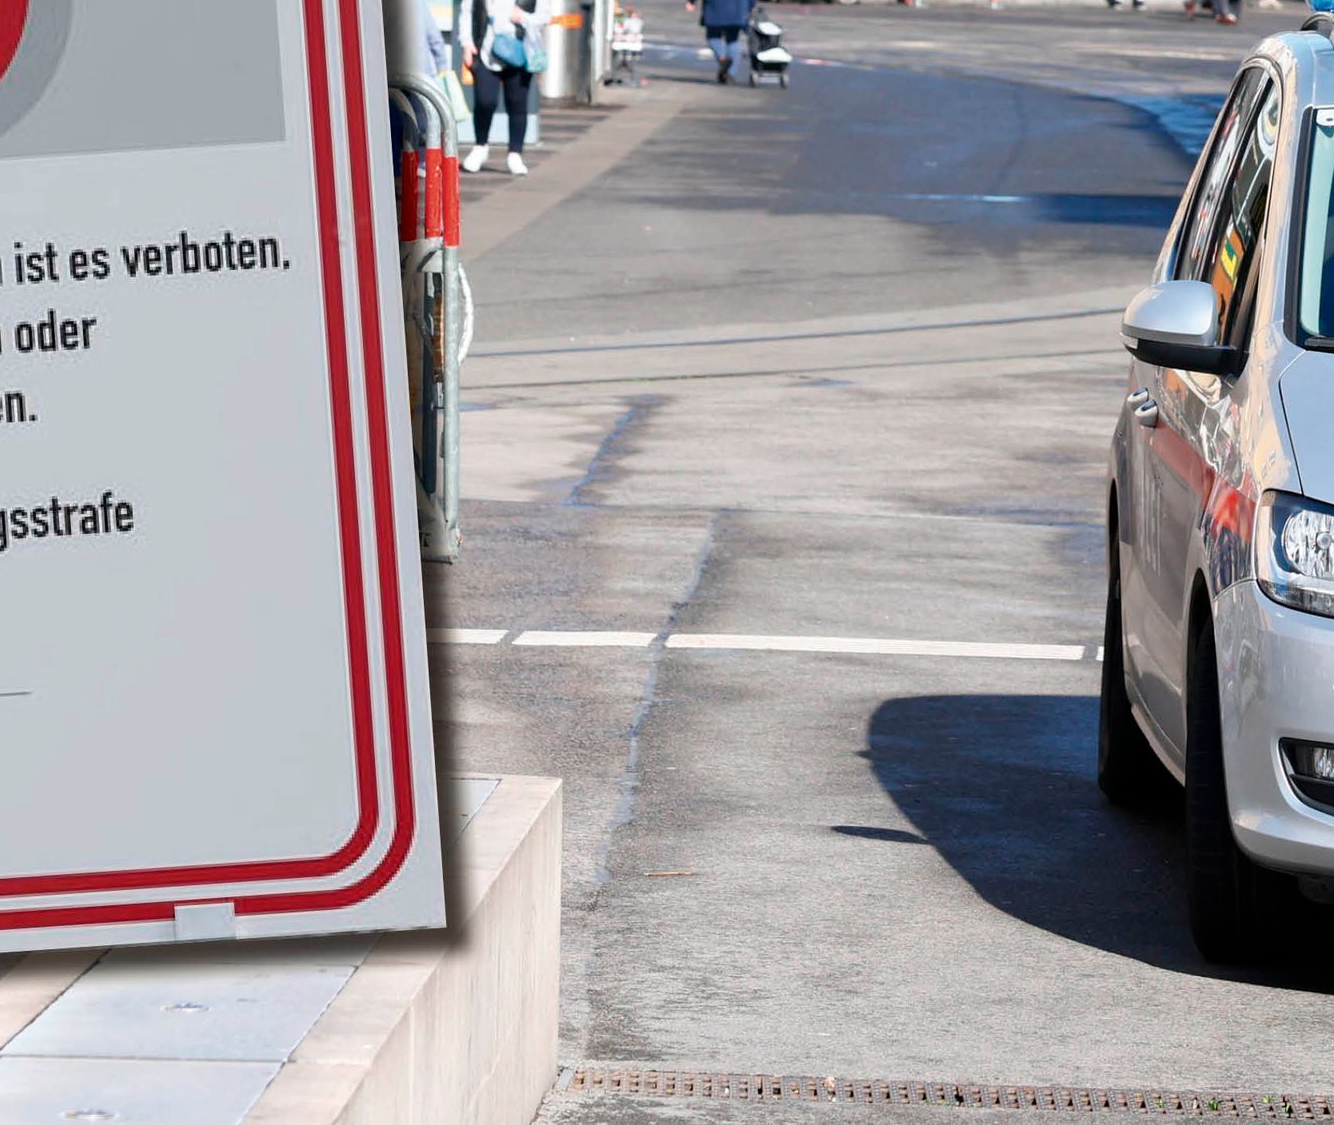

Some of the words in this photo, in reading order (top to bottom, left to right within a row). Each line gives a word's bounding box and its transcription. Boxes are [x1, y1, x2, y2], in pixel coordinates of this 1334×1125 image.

[13, 241, 60, 284] ist
[69, 248, 111, 281] es
[120, 234, 290, 278] verboten.
[14, 308, 97, 354] oder
